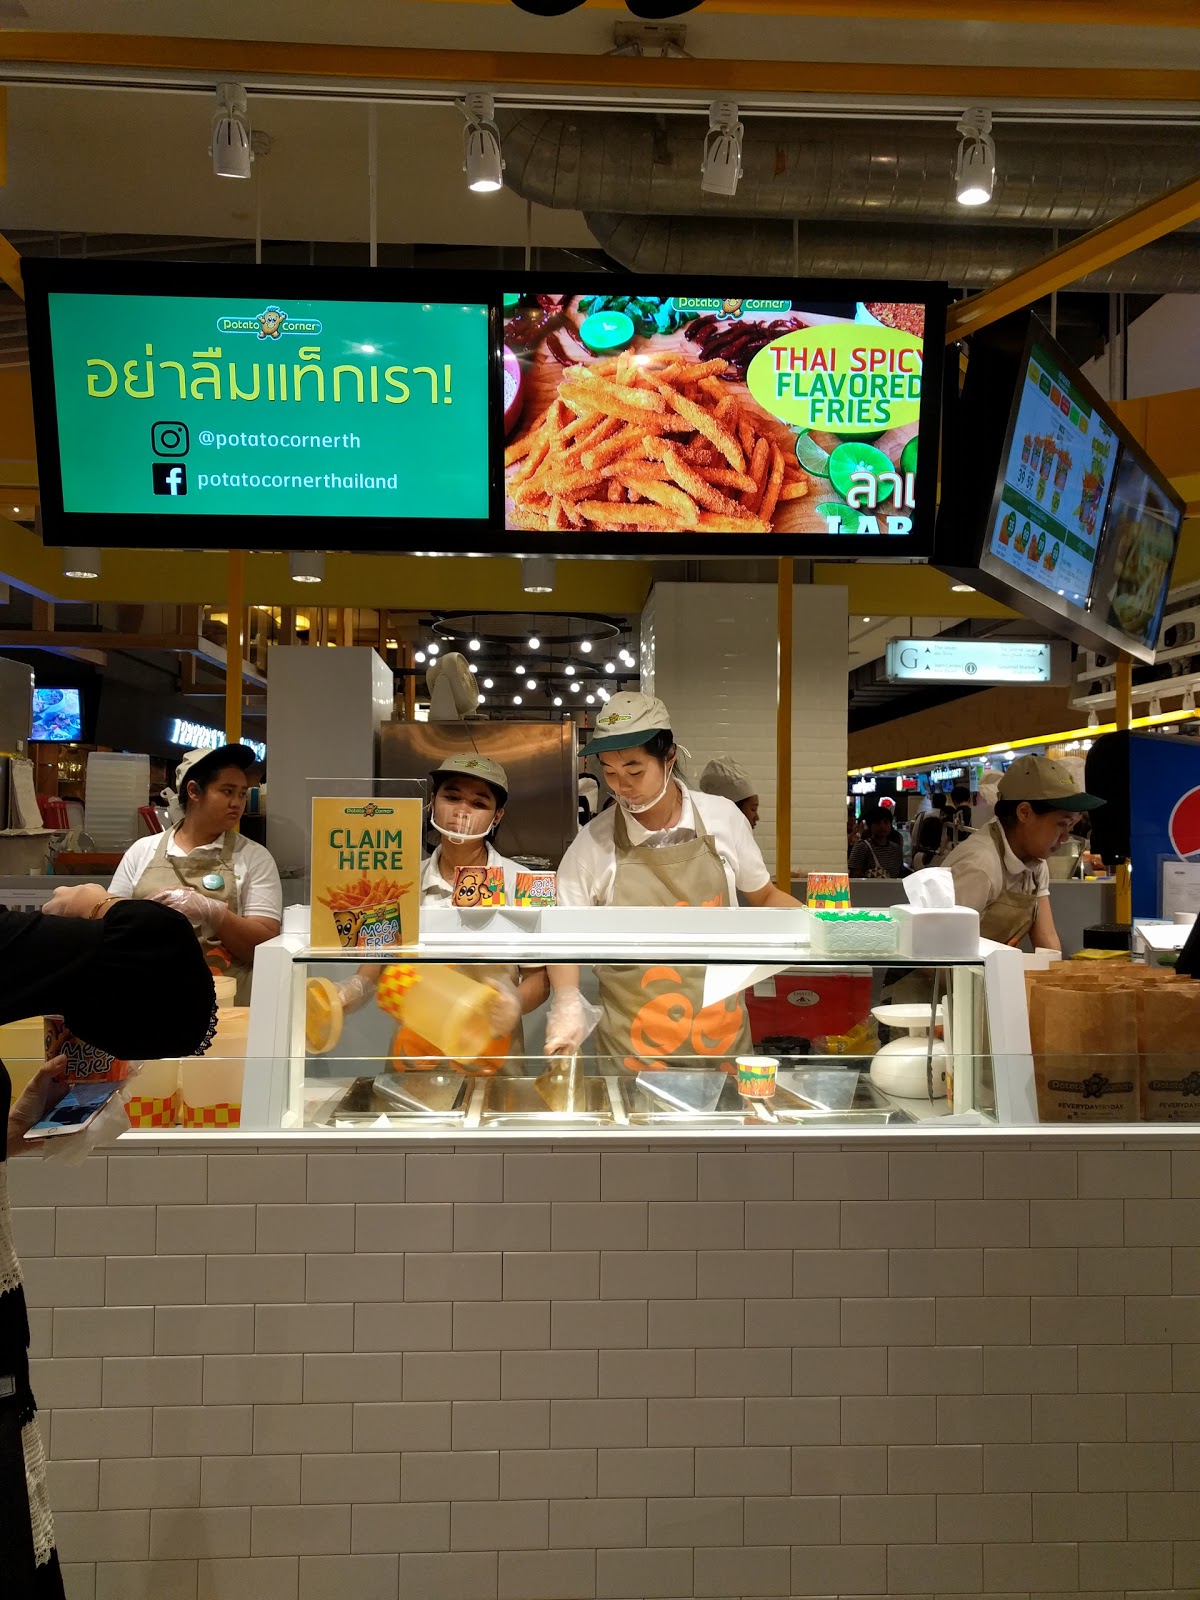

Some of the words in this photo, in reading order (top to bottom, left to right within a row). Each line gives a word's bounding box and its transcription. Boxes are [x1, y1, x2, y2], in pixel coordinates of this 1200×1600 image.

[679, 297, 720, 308] Potato
[223, 319, 260, 330] Potato
[768, 346, 837, 372] THAI
[86, 343, 453, 405] อย่าลืมแท็กเรา!
[776, 372, 923, 399] FLAVORED
[809, 398, 891, 425] FRIES
[198, 429, 361, 450] @potatocornerth
[197, 471, 398, 491] potatocornerthailand
[900, 648, 919, 669] G
[329, 827, 403, 849] CLAIM
[338, 849, 404, 871] HERE
